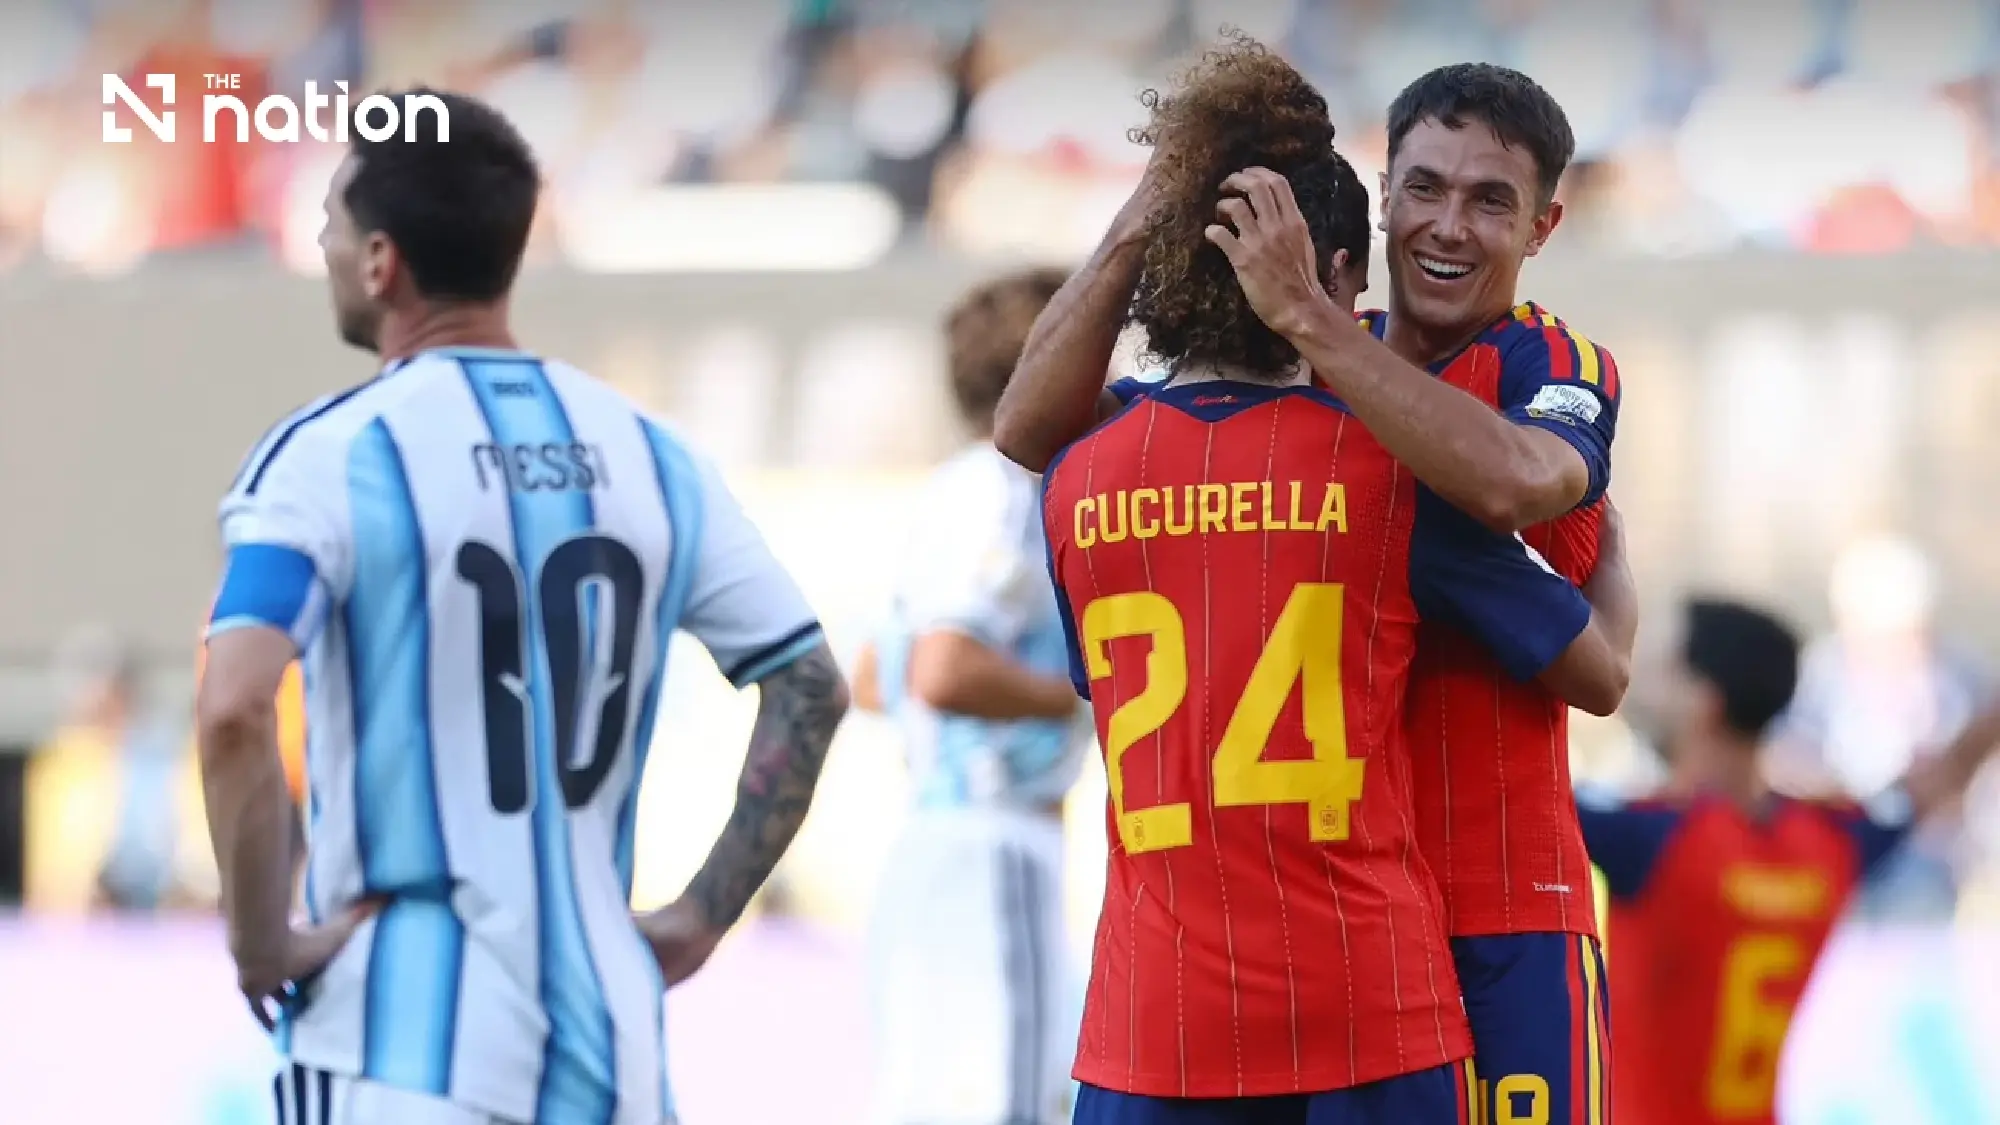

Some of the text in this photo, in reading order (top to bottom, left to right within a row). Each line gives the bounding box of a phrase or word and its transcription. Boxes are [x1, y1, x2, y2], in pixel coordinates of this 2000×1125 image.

[471, 442, 611, 492] MESSI
[1074, 481, 1347, 549] CUCURELLA
[456, 537, 643, 814] 10
[1083, 583, 1366, 856] 24
[1478, 1074, 1550, 1125] 8
